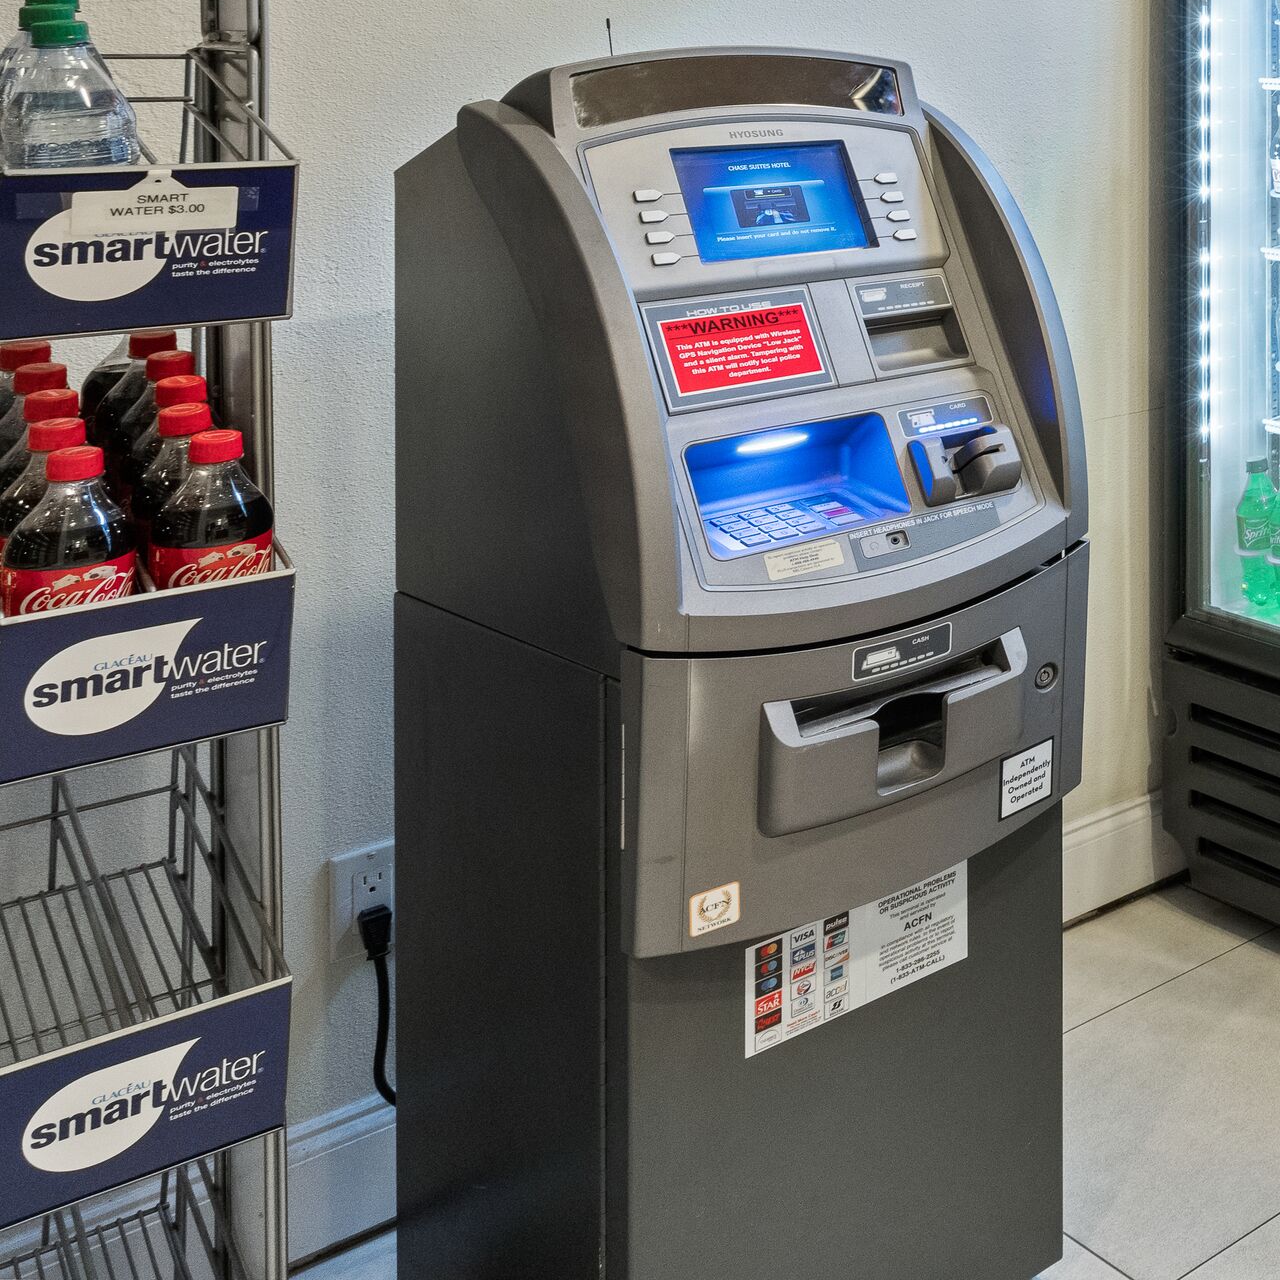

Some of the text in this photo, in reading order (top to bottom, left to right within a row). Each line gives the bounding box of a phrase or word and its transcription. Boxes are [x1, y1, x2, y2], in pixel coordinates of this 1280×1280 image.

[728, 128, 784, 139] HYOSUNG
[727, 161, 792, 172] CHASE SUITES HOTEL
[136, 192, 190, 205] SMART
[110, 203, 206, 217] WATER $3.00
[717, 234, 736, 242] Please
[736, 233, 753, 241] insert
[780, 229, 791, 237] and
[899, 281, 925, 289] RECEIPT
[686, 300, 772, 318] HOW TO USE
[676, 327, 801, 351] This ATM is equipped with Wireless
[678, 349, 697, 360] GPS
[697, 344, 737, 358] Navigation
[738, 341, 762, 352] Device
[683, 343, 804, 368] and a silent alarm. Tampering with
[691, 352, 801, 375] this ATM will notify local police
[728, 365, 772, 379] department.
[949, 402, 967, 410] CARD
[849, 501, 995, 540] INSERT HEADPHONES IN JACK FOR SPEECH MODE
[911, 635, 930, 646] CASH
[93, 652, 153, 672] GLACÉAU
[171, 669, 259, 692] purity electrolytes
[1019, 755, 1036, 769] ATM
[1002, 759, 1051, 787] Independently
[1007, 769, 1047, 795] Owned and
[1010, 781, 1044, 804] Operated
[877, 870, 957, 909] OPERATIONAL PROBLEMS
[879, 878, 956, 915] OR SUSPICIOUS ACTIVITY
[825, 916, 848, 932] pulse
[903, 912, 932, 932] ACFN
[792, 929, 815, 943] VISA
[757, 998, 781, 1015] STAR
[91, 1080, 151, 1106] GLACÉAU
[169, 1078, 258, 1114] purity electrolytes
[168, 1088, 255, 1121] taste the difference
